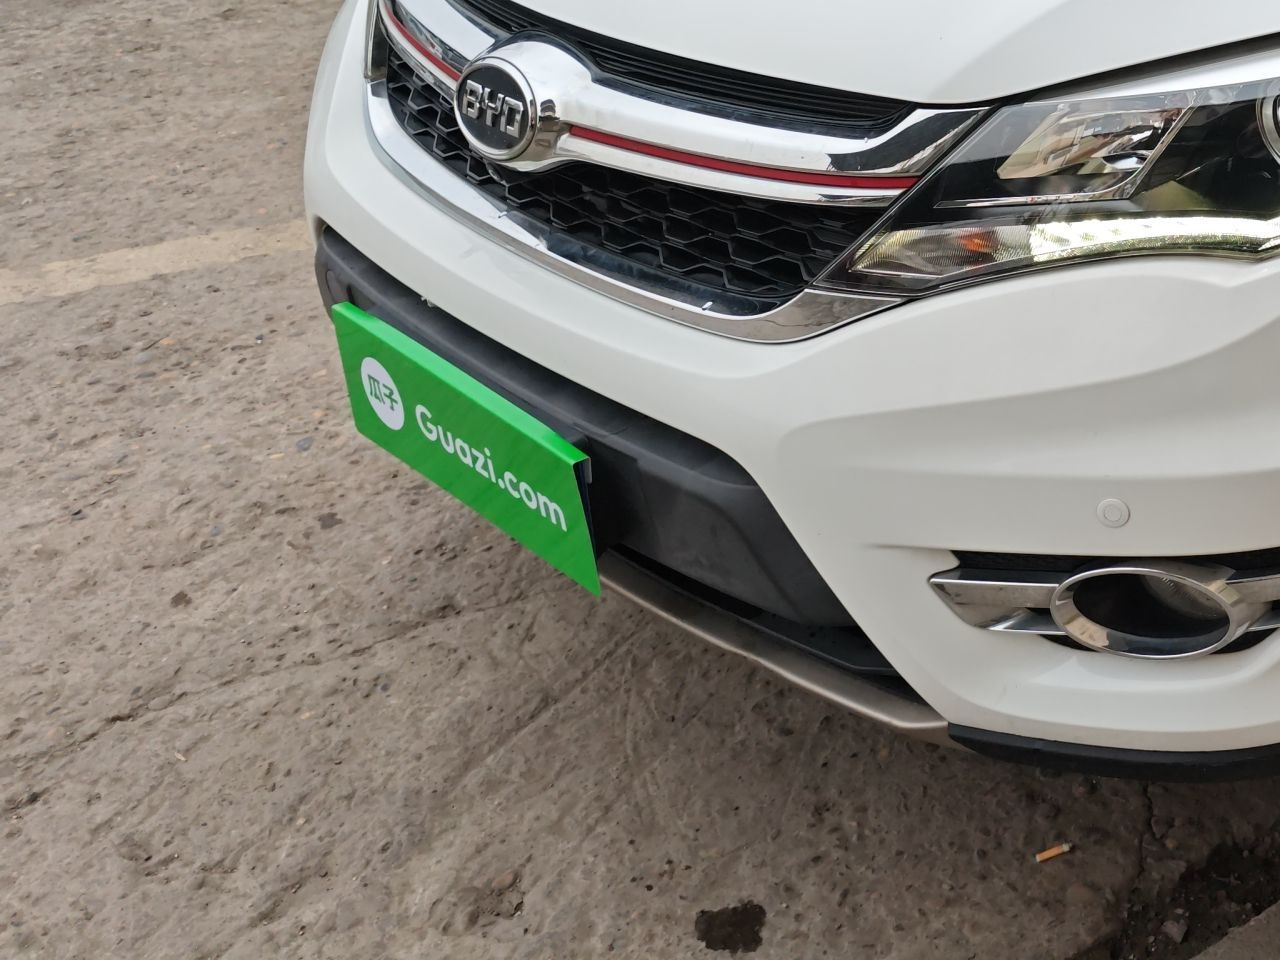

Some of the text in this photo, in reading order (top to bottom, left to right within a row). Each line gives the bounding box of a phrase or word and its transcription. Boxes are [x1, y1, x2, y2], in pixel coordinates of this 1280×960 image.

[461, 79, 524, 138] BYD
[367, 373, 399, 411] 瓜子
[414, 403, 568, 533] Guazi.com
